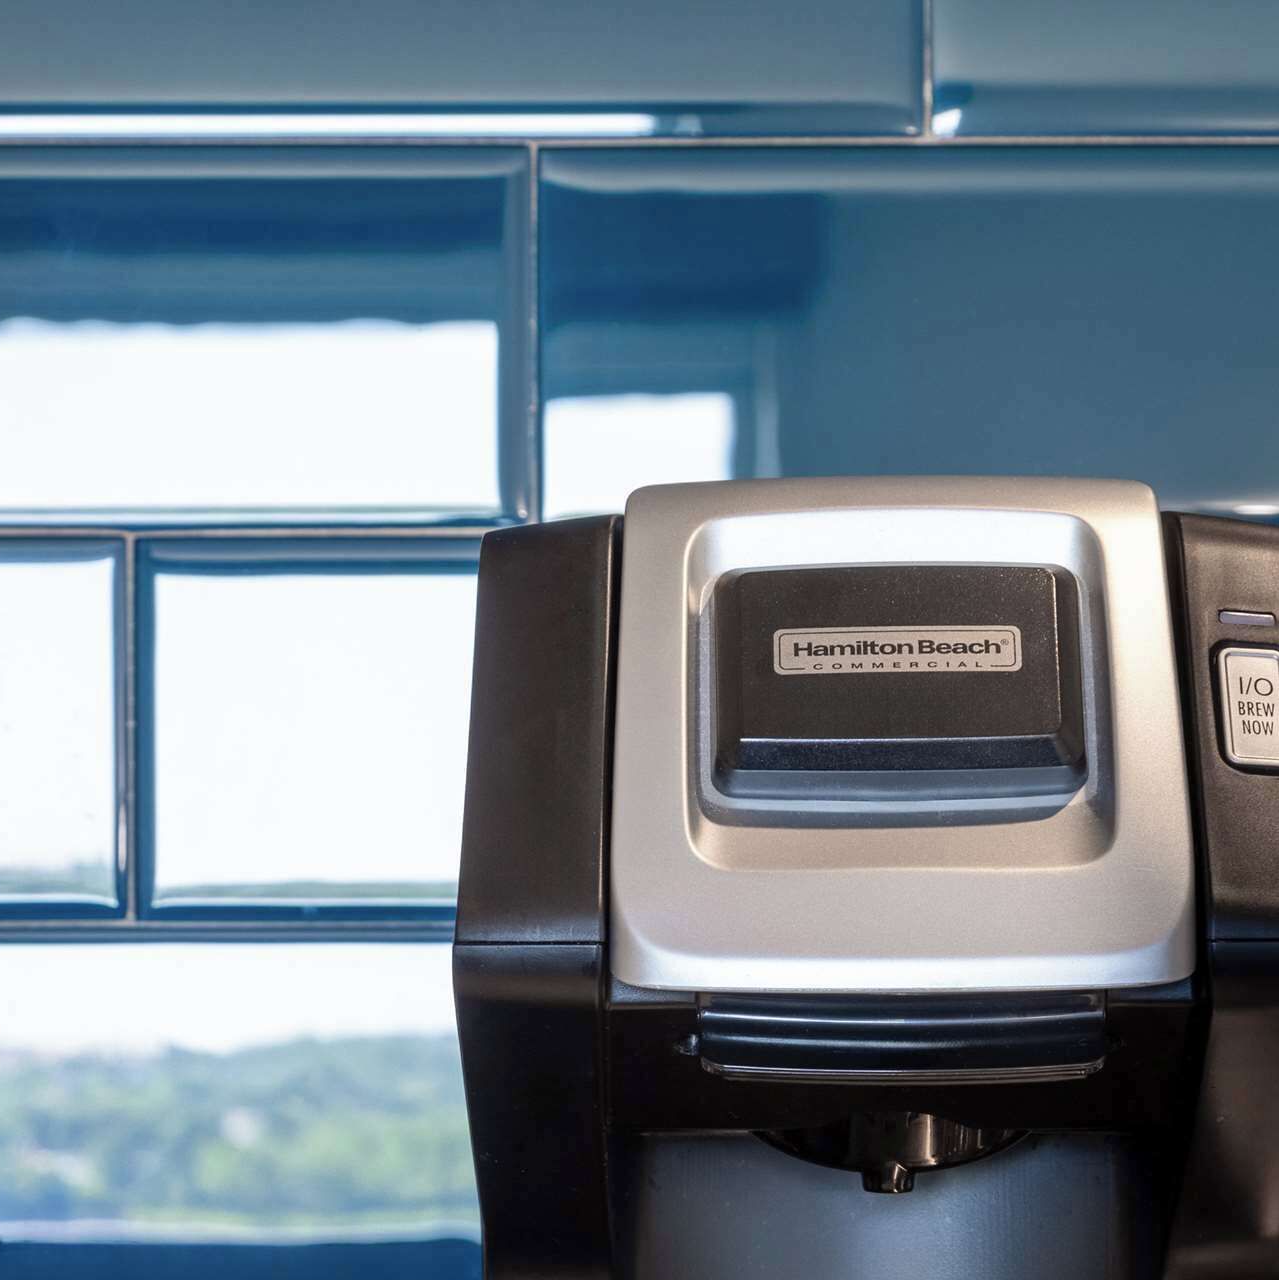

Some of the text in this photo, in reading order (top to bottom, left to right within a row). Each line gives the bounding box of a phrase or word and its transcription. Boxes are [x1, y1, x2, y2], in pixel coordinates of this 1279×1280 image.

[793, 639, 914, 658] Hamilton
[813, 661, 984, 671] COMMERCIAL
[1237, 700, 1276, 718] BREW
[1241, 720, 1275, 736] NOW
